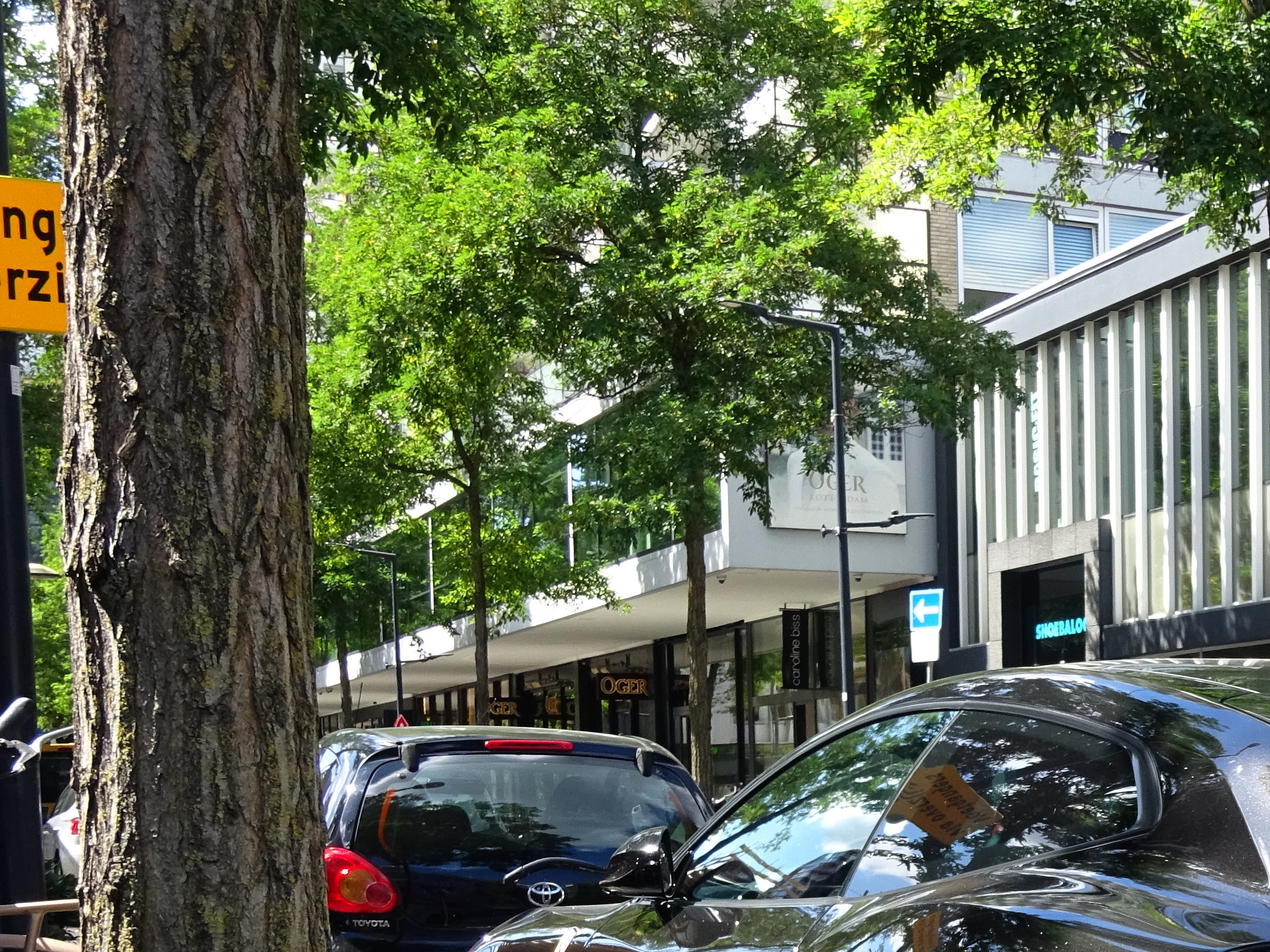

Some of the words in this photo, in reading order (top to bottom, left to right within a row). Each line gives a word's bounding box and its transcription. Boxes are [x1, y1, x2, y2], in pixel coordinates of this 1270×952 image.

[809, 493, 869, 504] ROTTDAM
[789, 614, 801, 637] biss
[789, 639, 801, 686] caroline
[600, 676, 649, 697] OGER
[489, 701, 522, 718] GER
[352, 919, 391, 928] TOYOTA
